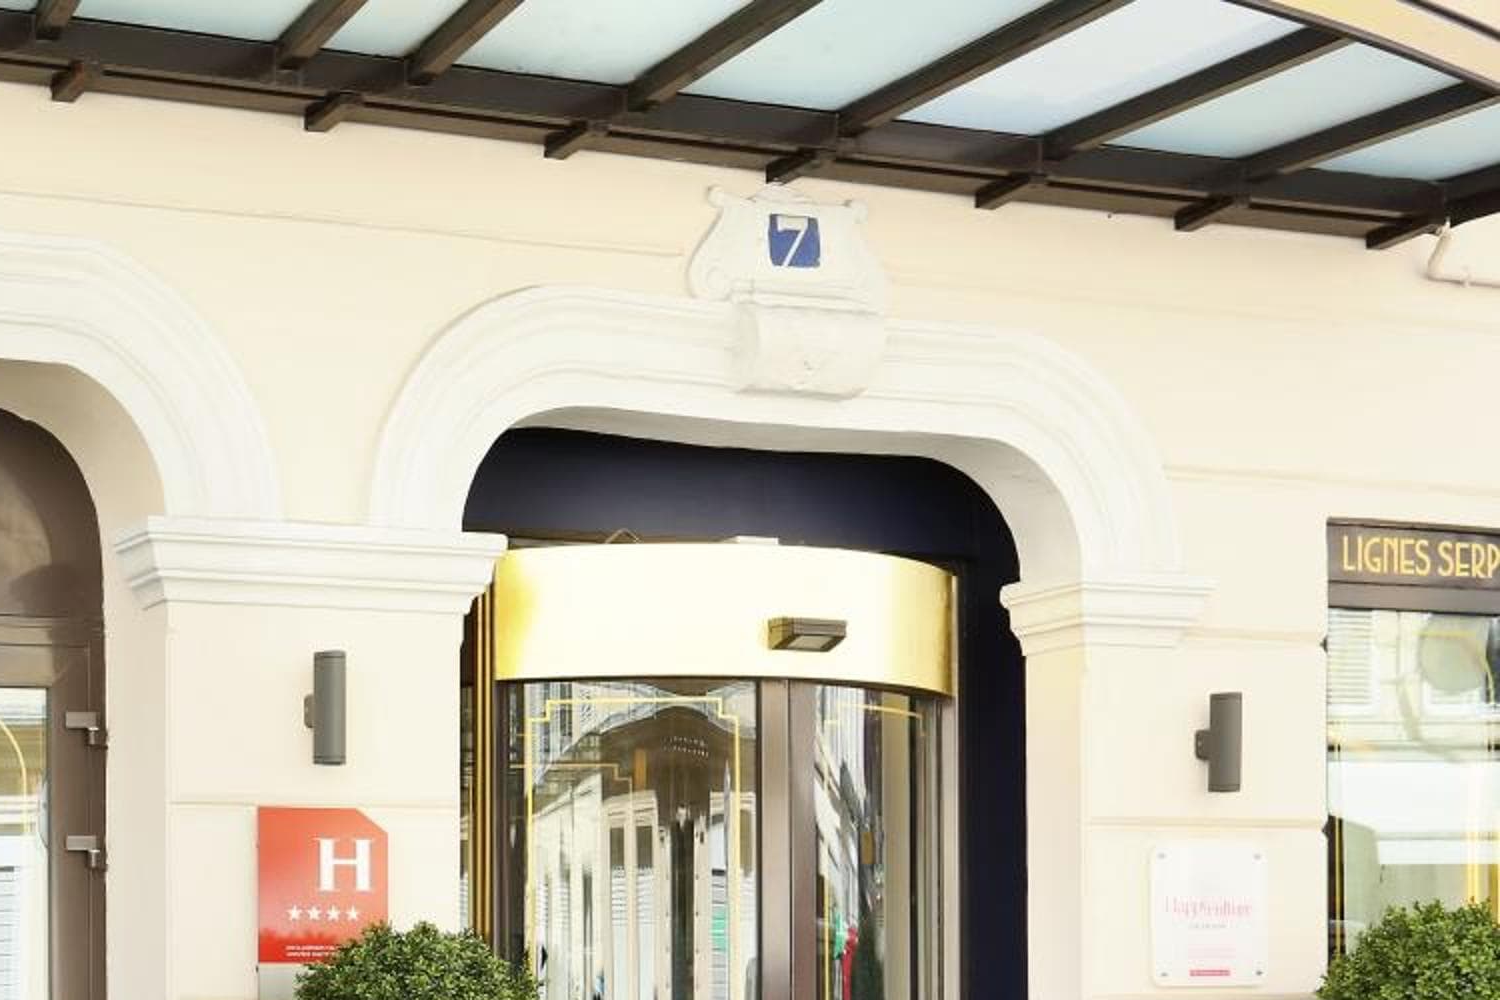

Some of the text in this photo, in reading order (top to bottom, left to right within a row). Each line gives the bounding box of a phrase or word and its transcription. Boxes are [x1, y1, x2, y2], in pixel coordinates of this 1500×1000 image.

[777, 215, 808, 267] 7
[1342, 535, 1431, 576] LIGNES
[319, 837, 372, 892] H
